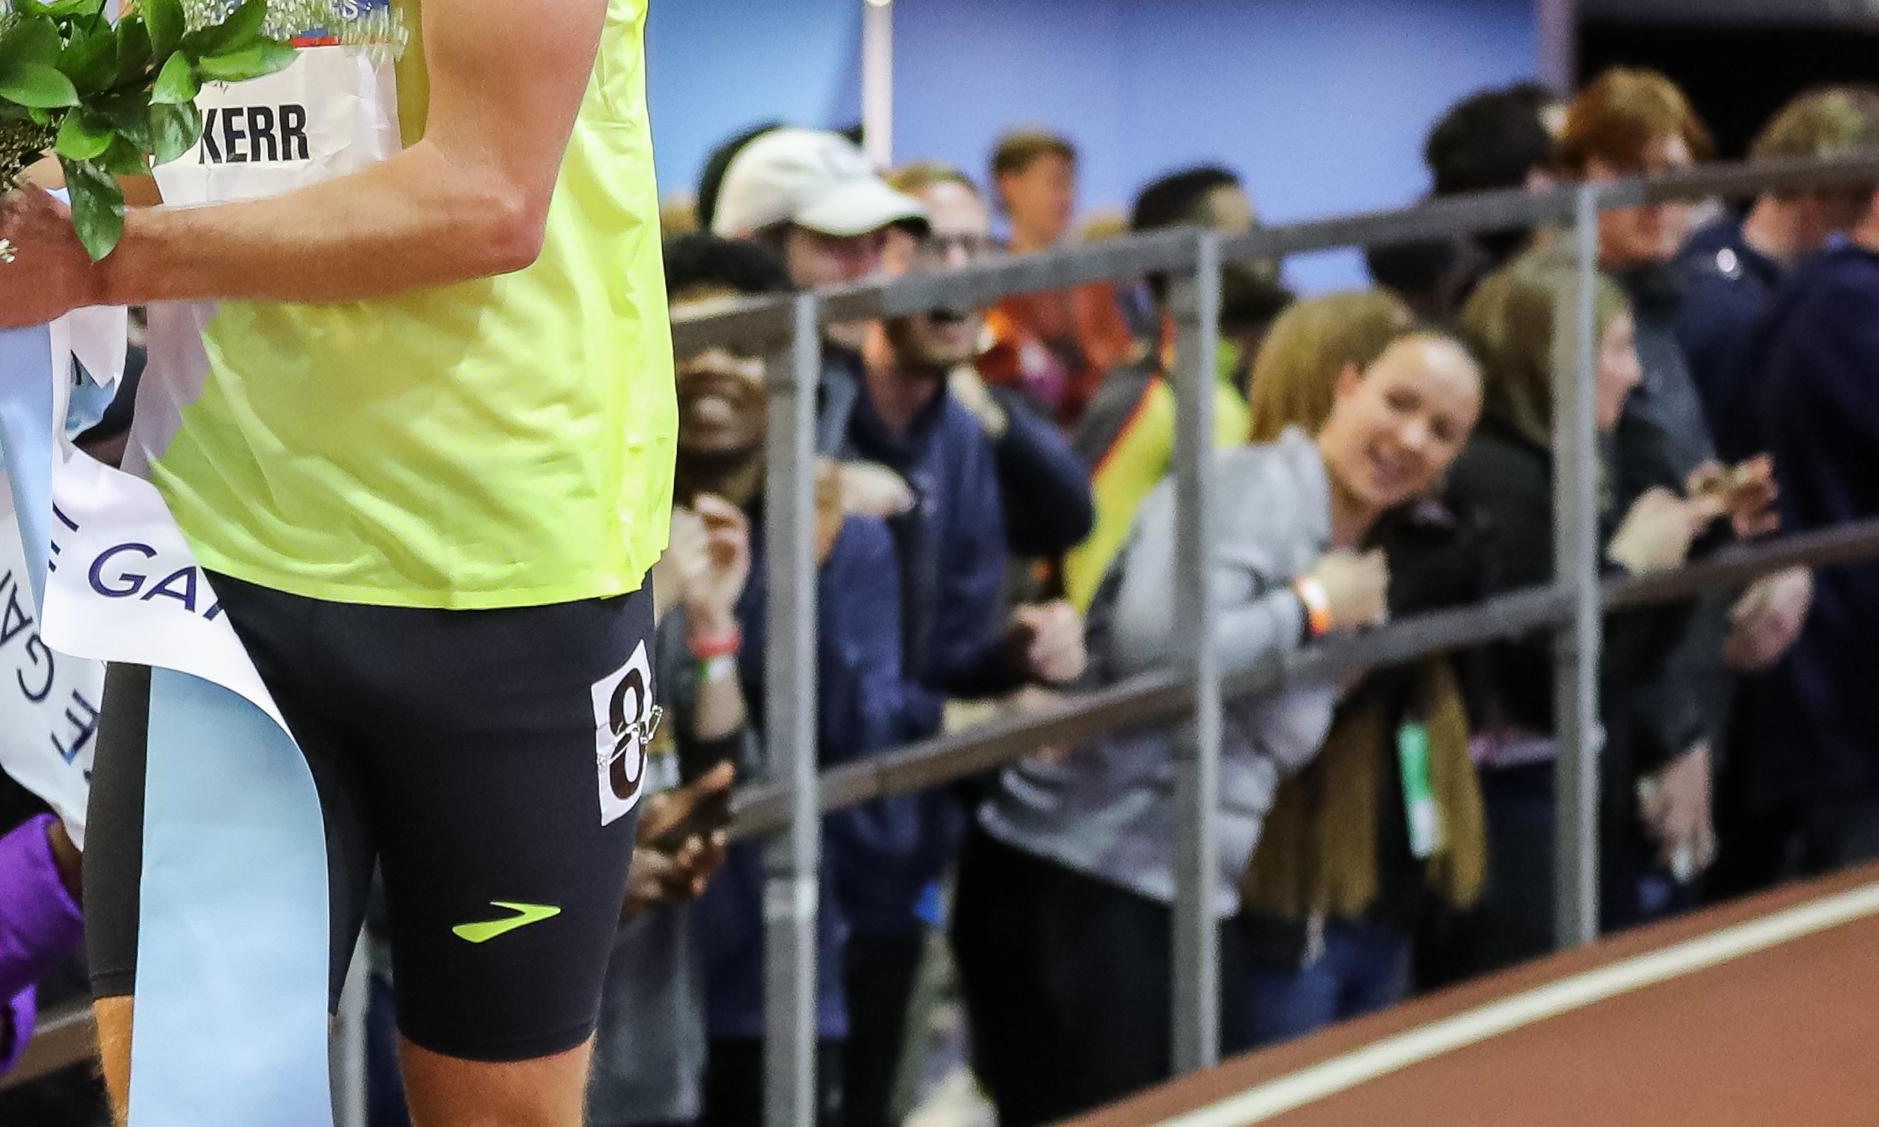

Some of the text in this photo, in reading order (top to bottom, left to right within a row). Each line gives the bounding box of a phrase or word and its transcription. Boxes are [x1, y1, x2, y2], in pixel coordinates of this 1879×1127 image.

[199, 104, 310, 164] KERR
[88, 542, 224, 621] GA
[609, 667, 647, 800] 8
